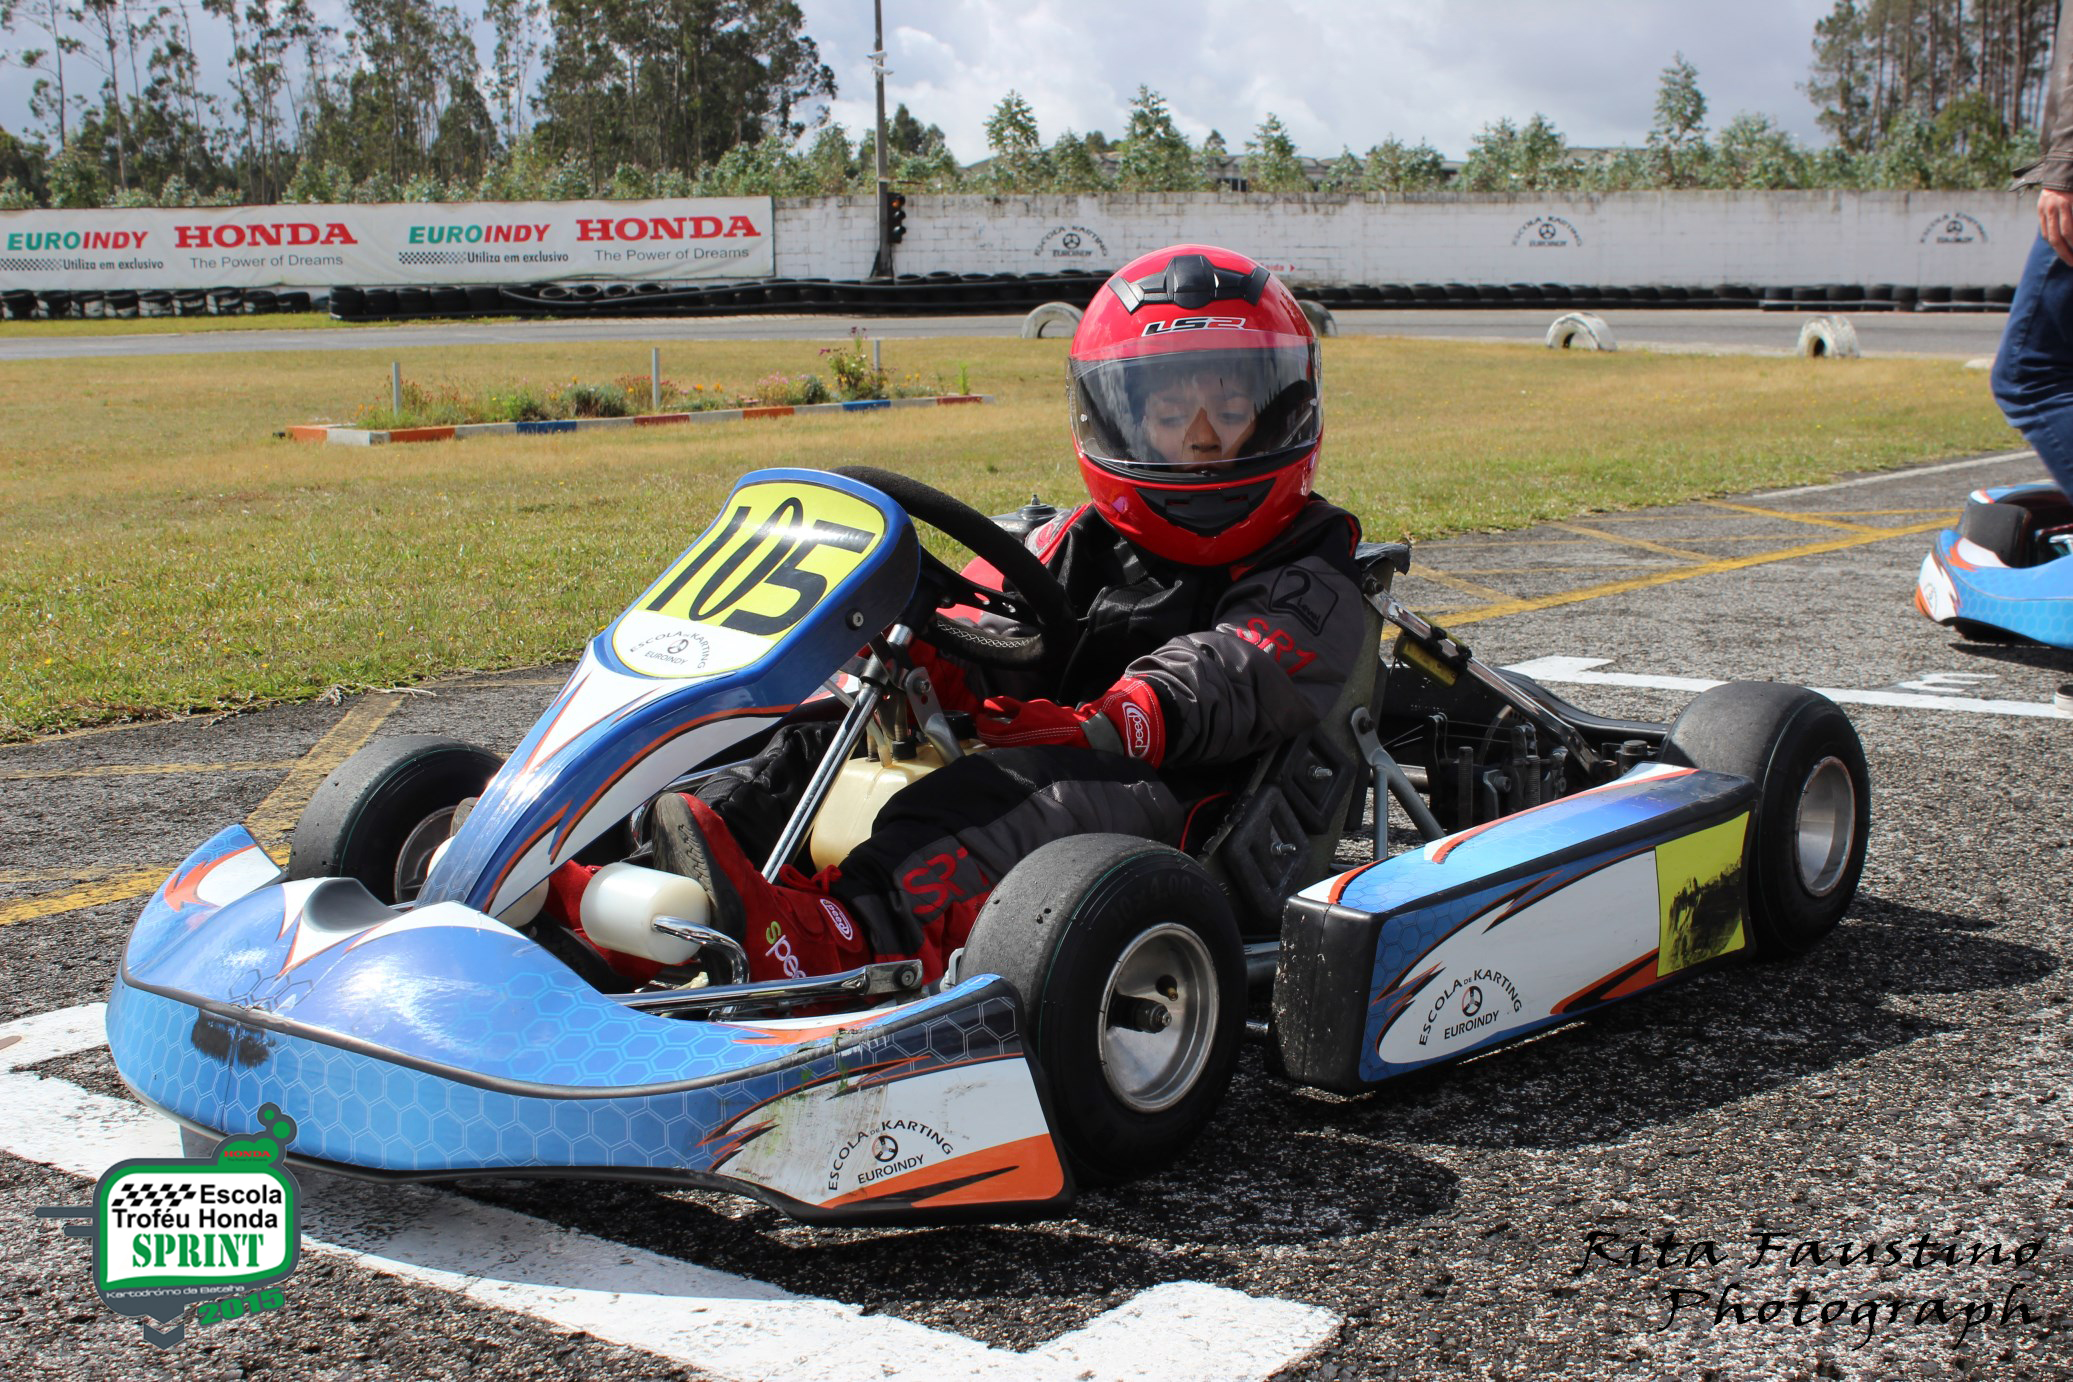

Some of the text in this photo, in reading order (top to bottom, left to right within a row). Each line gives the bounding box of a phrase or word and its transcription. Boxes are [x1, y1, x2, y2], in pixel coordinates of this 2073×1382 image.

[174, 223, 358, 248] HONDA
[408, 224, 551, 244] EUROINDY
[576, 216, 761, 242] HONDA
[7, 231, 148, 251] EUROINDY
[62, 257, 164, 270] Utiliza em exclusivo
[190, 254, 344, 269] The Power of Dreams
[467, 251, 569, 263] Utiliza em exclusivo
[594, 247, 750, 262] The Power of Dreams
[1141, 316, 1246, 337] LS2
[645, 497, 876, 636] 105
[630, 631, 710, 669] ESCOLA KARTING
[644, 650, 689, 665] EUROINDY
[1418, 978, 1463, 1046] ESCOLA
[1473, 968, 1523, 1013] KARTING
[1444, 1009, 1500, 1040] EUROINDY
[828, 1131, 869, 1191] ESCOLA
[881, 1119, 954, 1156] KARTING
[857, 1153, 924, 1185] EUROINDY
